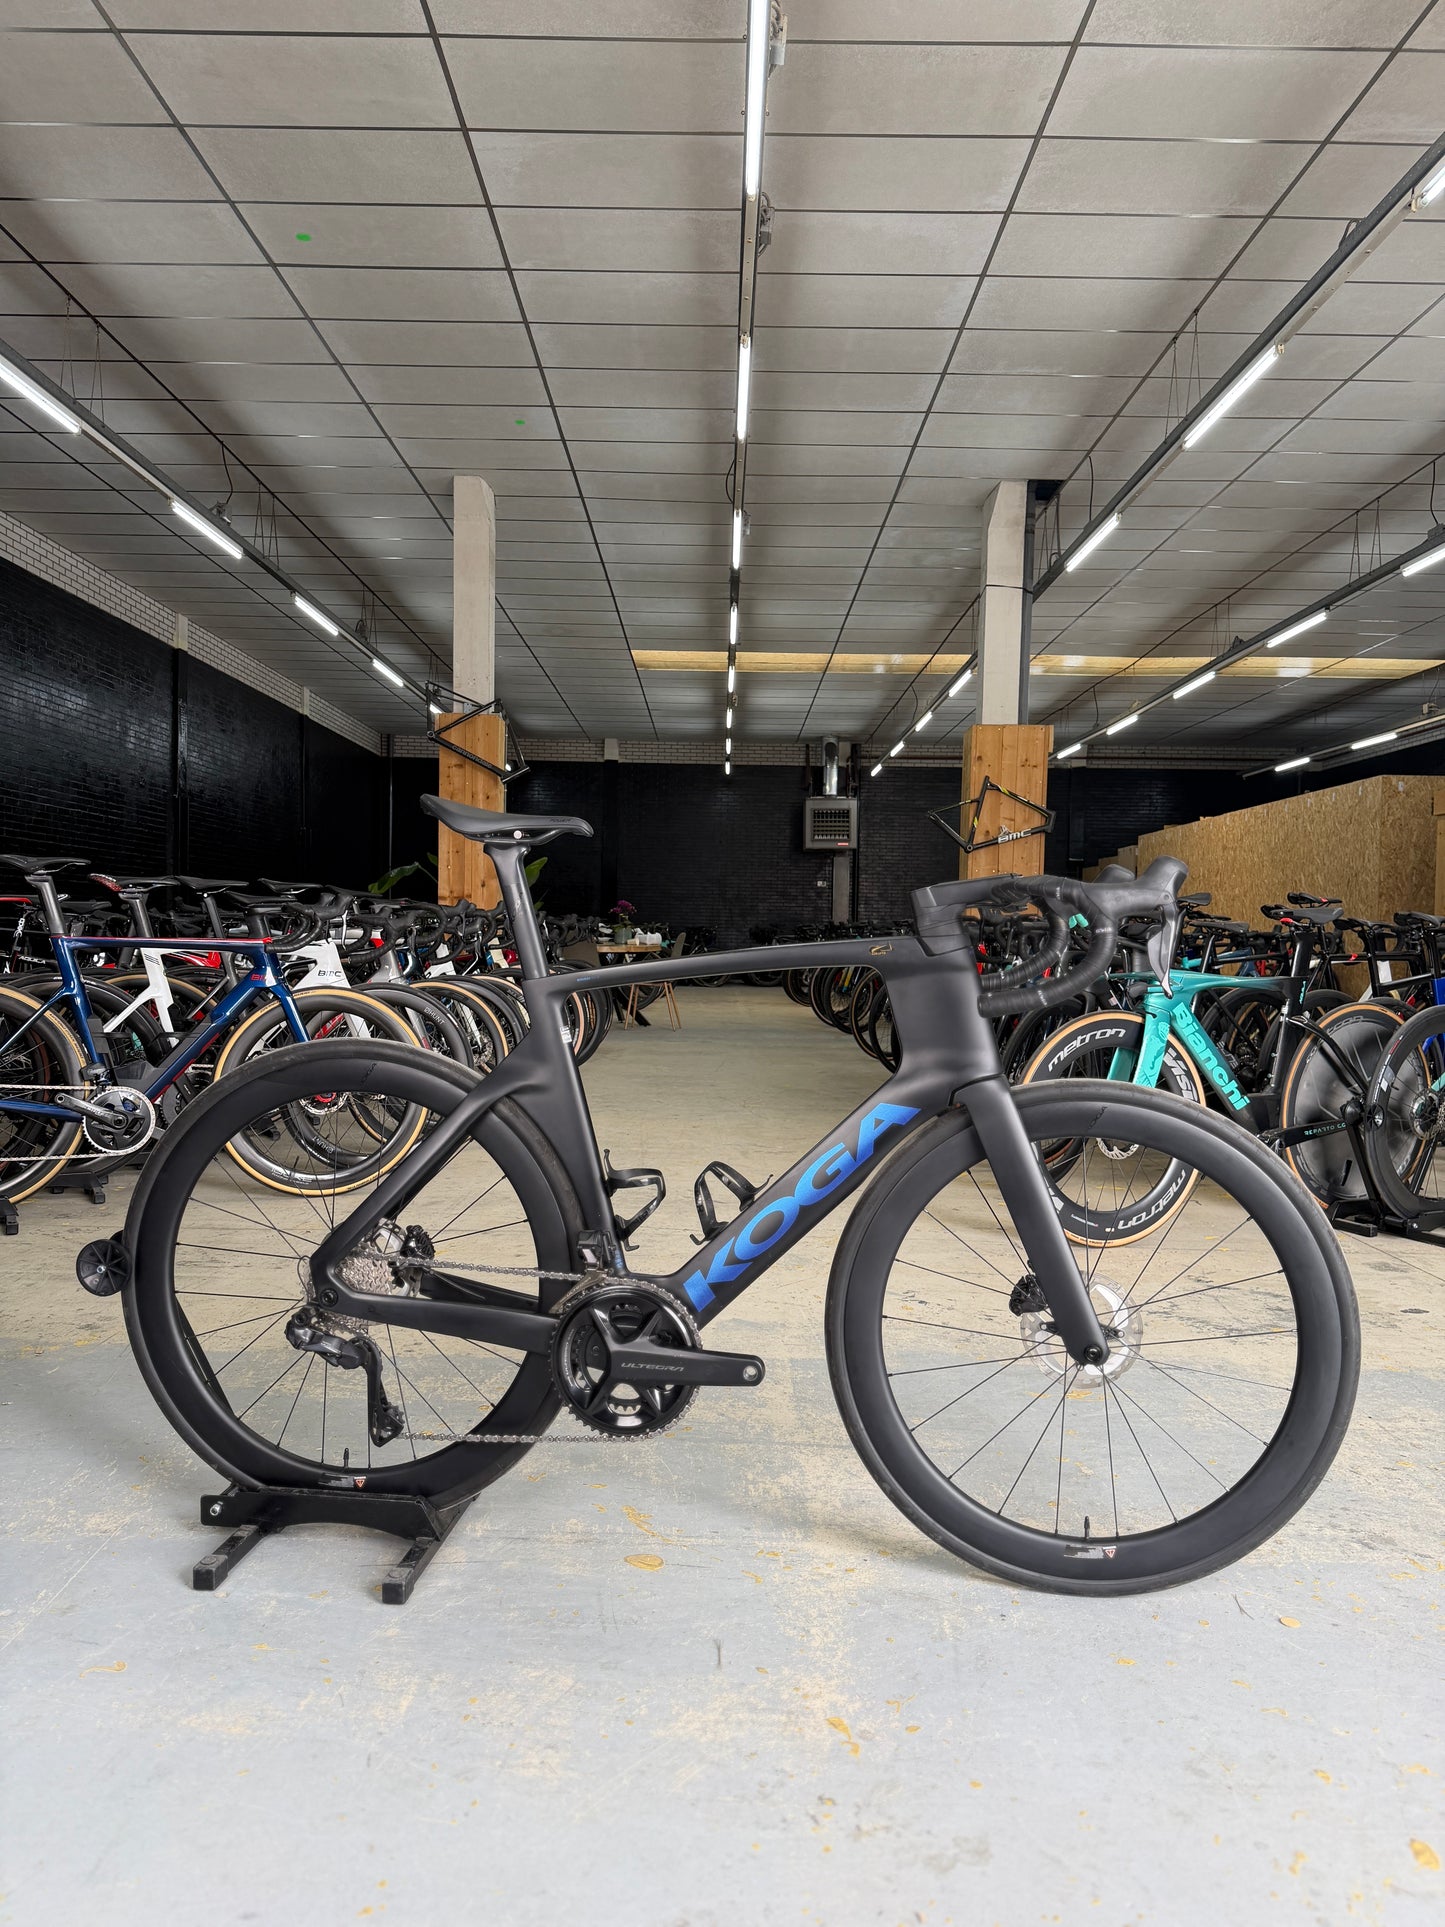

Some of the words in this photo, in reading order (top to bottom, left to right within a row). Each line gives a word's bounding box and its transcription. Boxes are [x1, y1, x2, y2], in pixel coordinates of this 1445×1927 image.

[452, 745, 493, 768] cannondale
[997, 828, 1032, 844] BMC
[317, 969, 343, 978] BMC
[428, 1008, 446, 1026] HUNT
[1047, 1028, 1127, 1073] metron
[1172, 1002, 1251, 1111] Bianchi
[682, 1102, 922, 1313] KOGA
[1117, 1169, 1187, 1230] metron
[620, 1361, 686, 1373] ULTEGRA
